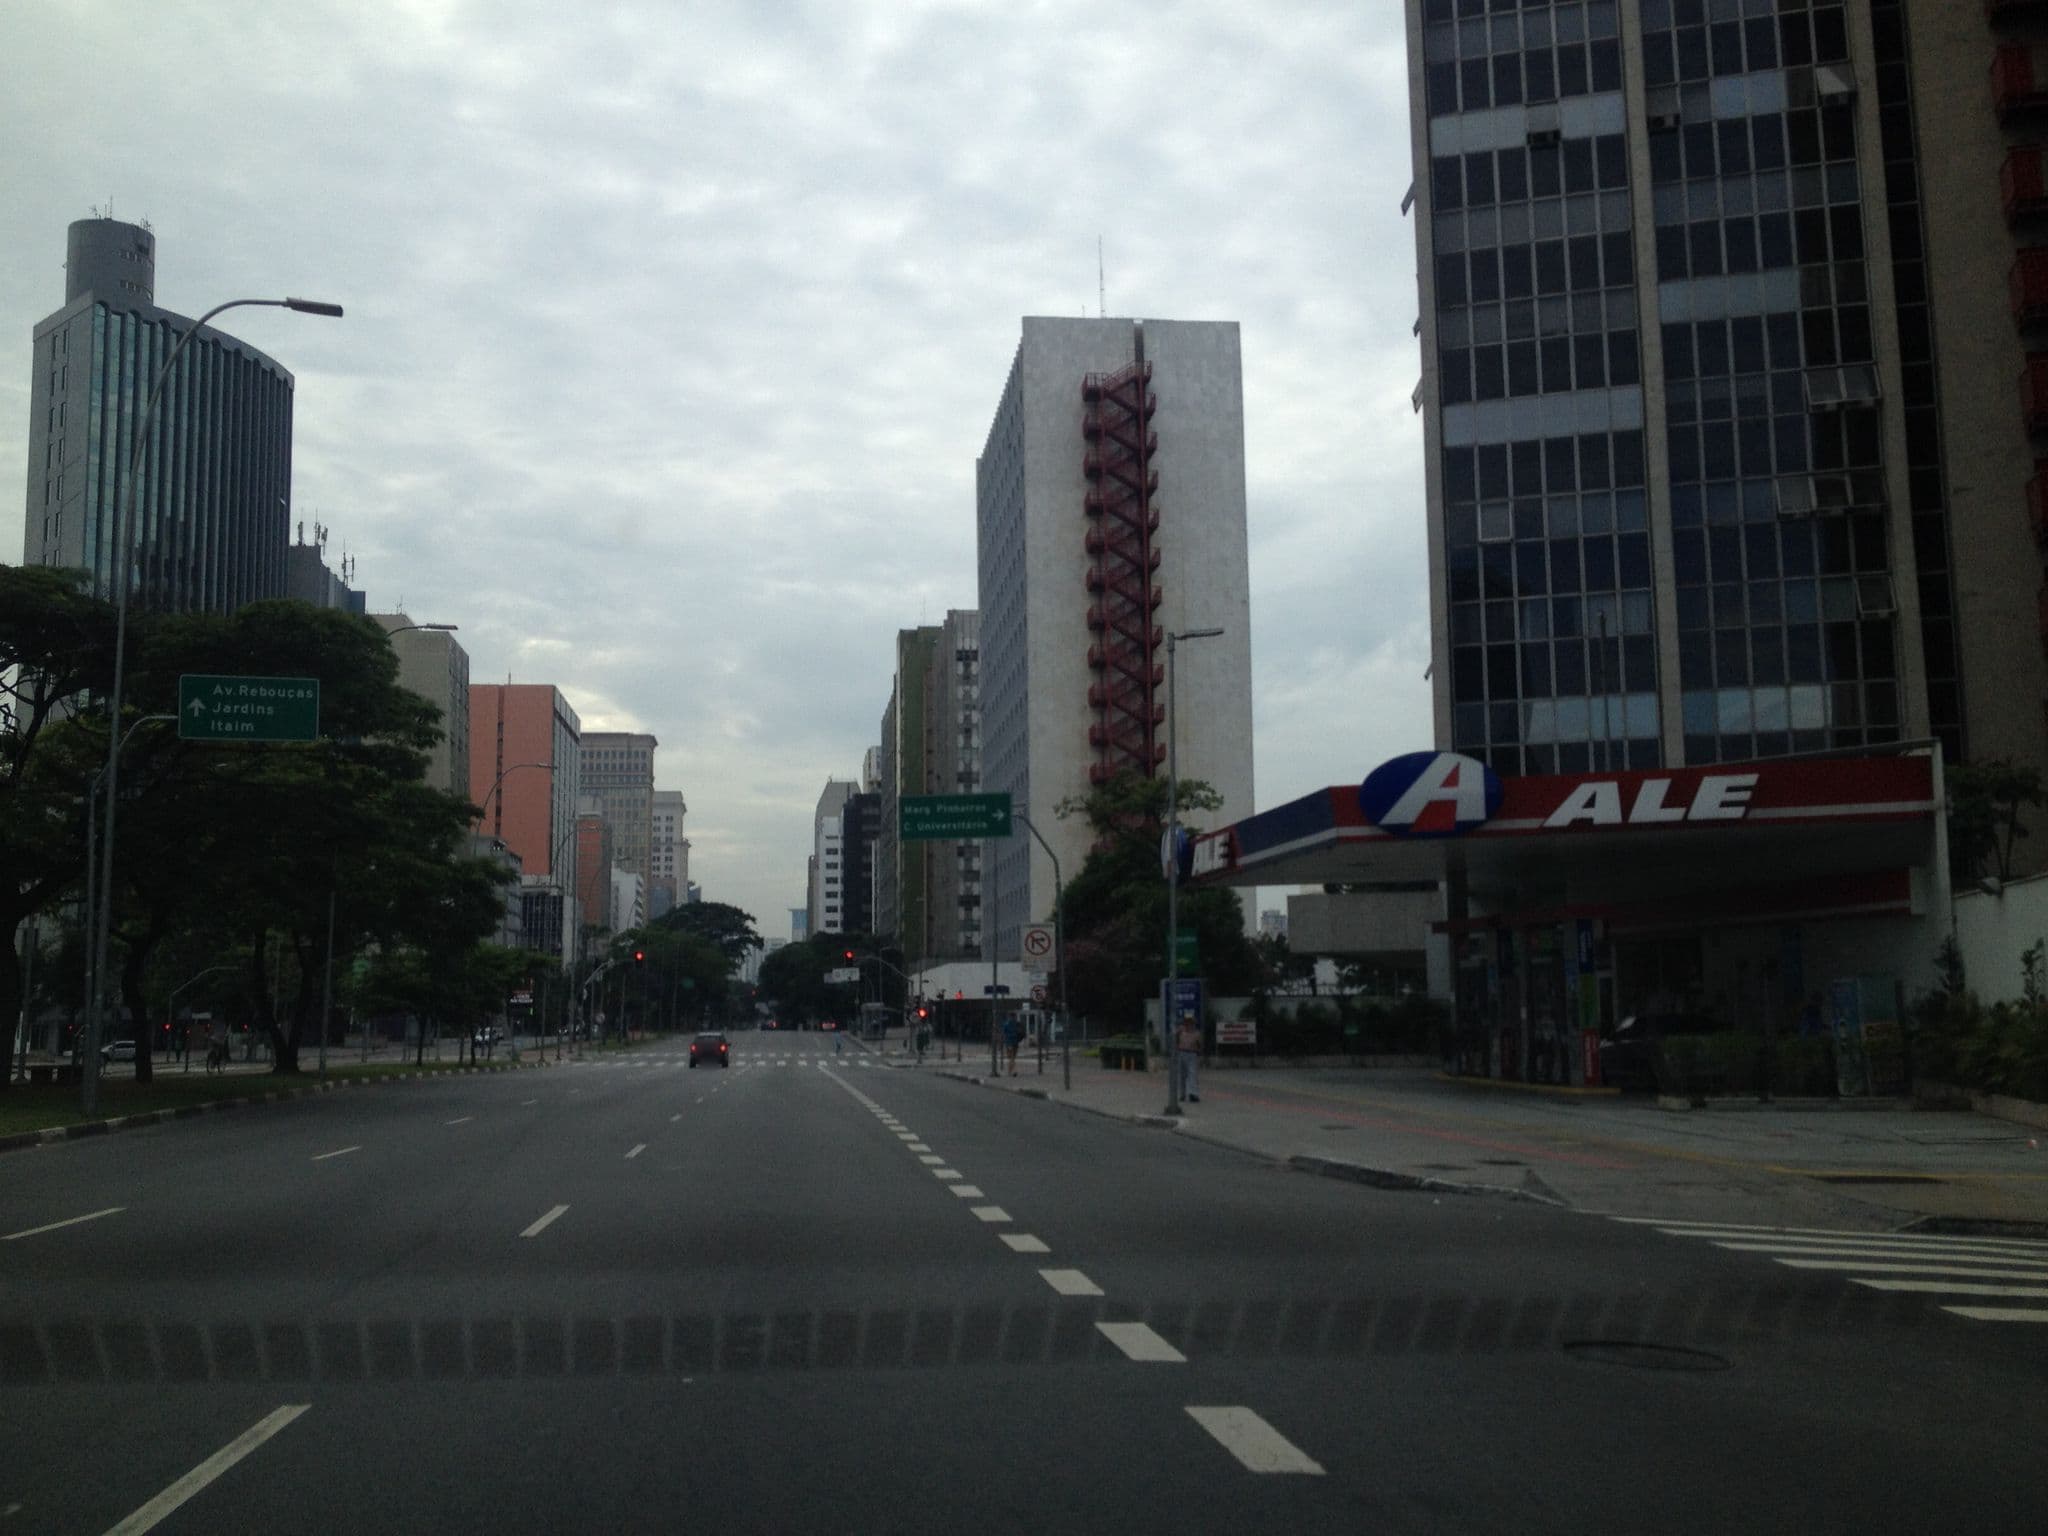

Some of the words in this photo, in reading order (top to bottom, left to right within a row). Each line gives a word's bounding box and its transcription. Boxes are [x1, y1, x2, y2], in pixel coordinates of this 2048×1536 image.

[212, 701, 275, 715] Jardins
[211, 720, 255, 732] Itaim
[1377, 750, 1487, 826] A
[1540, 773, 1760, 828] ALE
